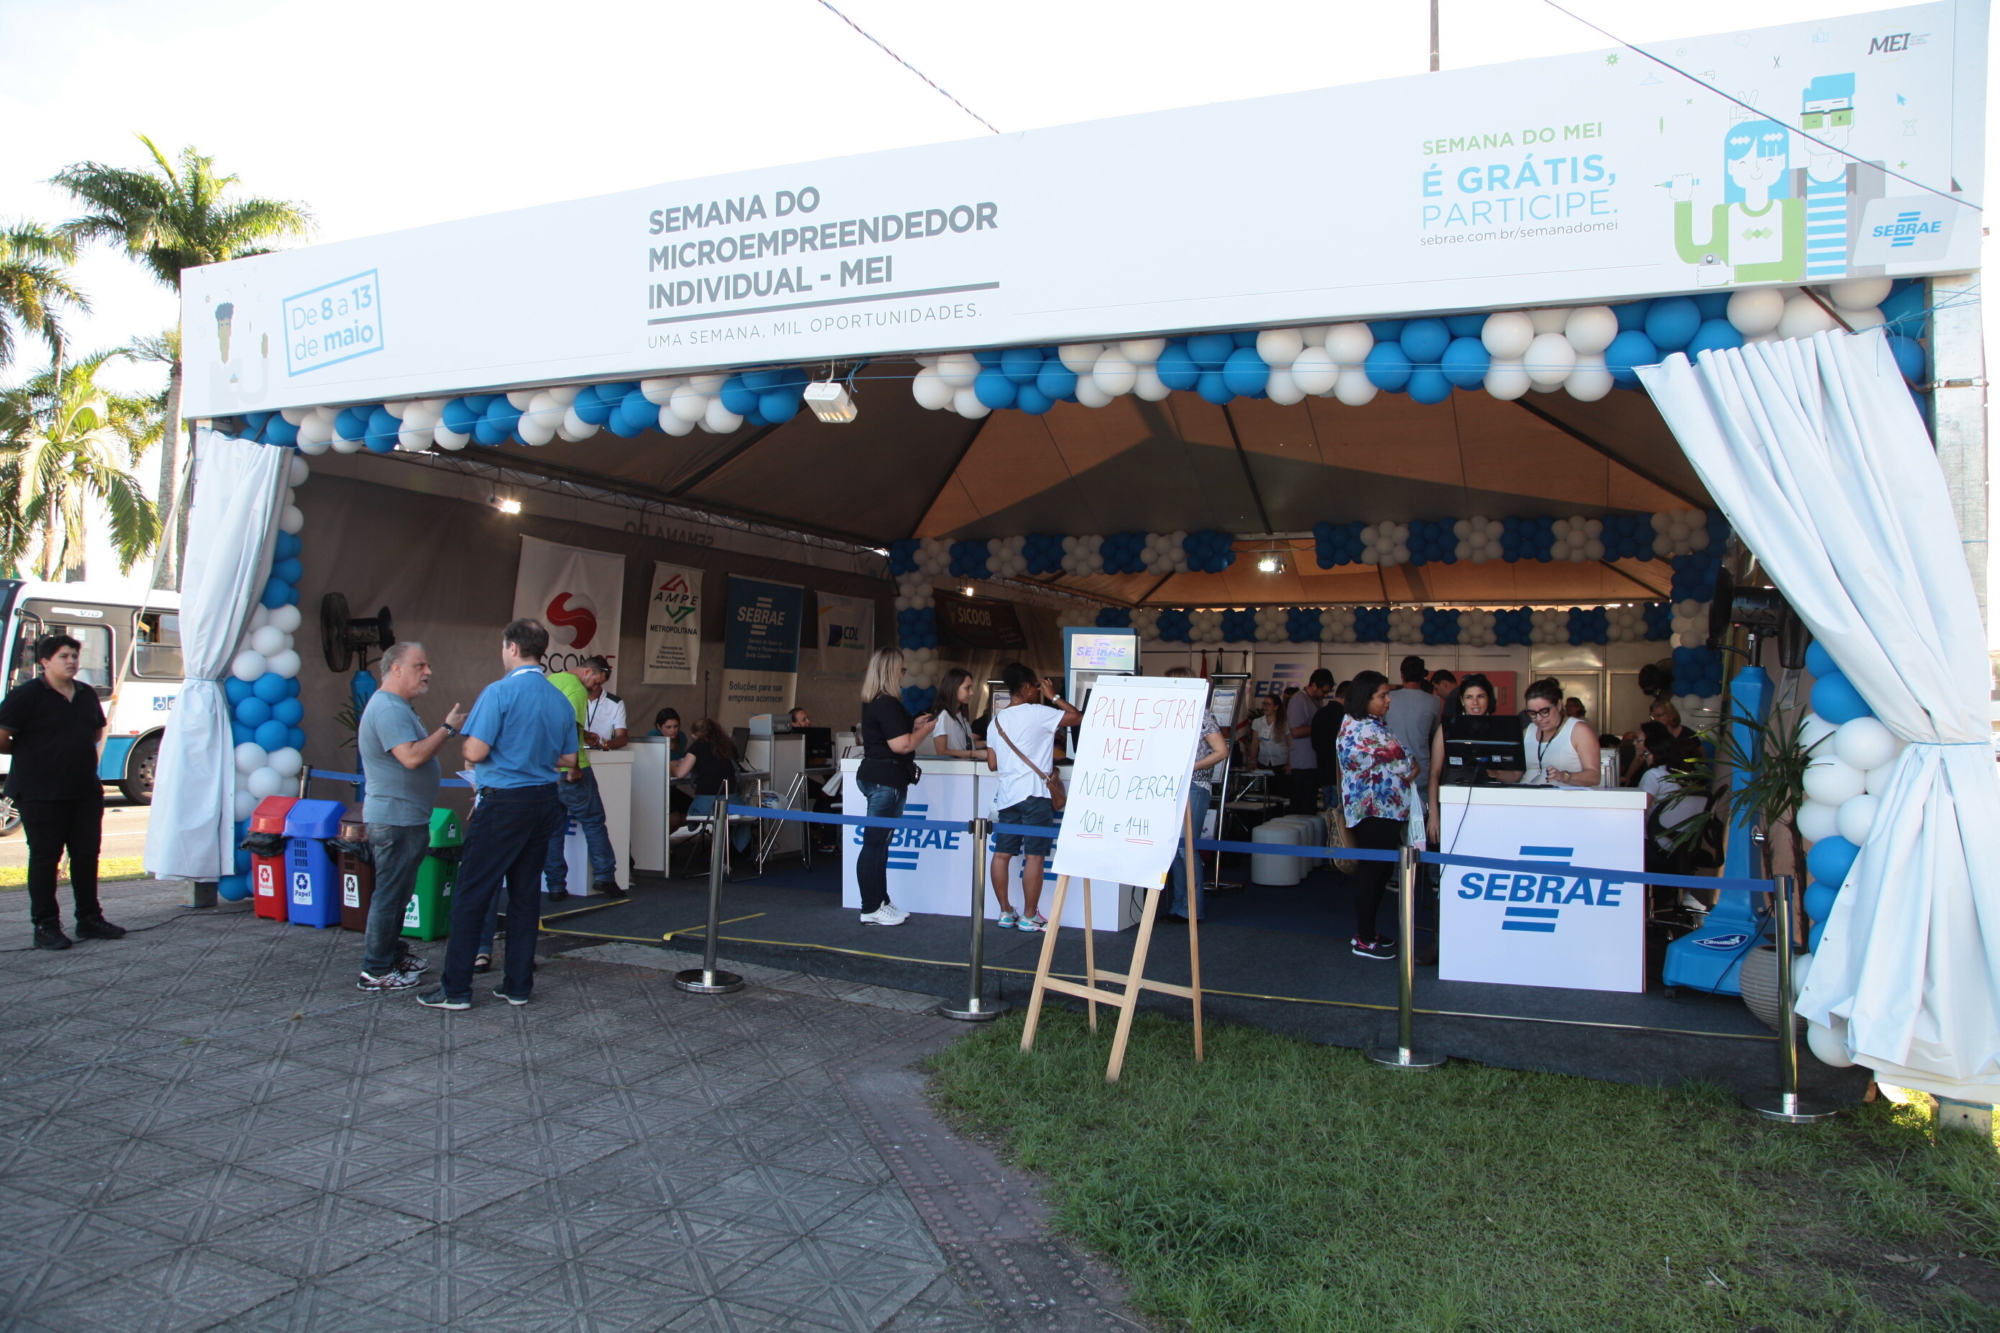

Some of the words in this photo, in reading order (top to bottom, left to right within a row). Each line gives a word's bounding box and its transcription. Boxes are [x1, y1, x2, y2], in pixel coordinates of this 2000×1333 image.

[1868, 32, 1911, 55] MEI
[1422, 130, 1514, 156] SEMANA
[1525, 126, 1556, 145] DO
[1563, 120, 1602, 140] MEI
[1422, 163, 1443, 197] É
[1457, 154, 1617, 193] GRÁTIS,
[648, 194, 767, 235] SEMANA
[775, 186, 820, 217] DO
[1422, 189, 1619, 230] PARTICIPE.
[648, 201, 998, 272] MICROEMPREENDEDOR
[1420, 219, 1619, 246] sebrae.com.br/semanadomei
[1872, 220, 1942, 238] SEBRAE
[648, 266, 812, 309] INDIVIDUAL
[840, 255, 893, 287] MEI
[292, 307, 317, 330] De
[321, 297, 333, 320] 8
[337, 298, 348, 316] a
[351, 284, 372, 310] 13
[648, 333, 682, 349] UMA
[689, 325, 766, 345] SEMANA,
[773, 319, 802, 336] MIL
[810, 302, 983, 333] OPORTUNIDADES.
[294, 335, 318, 360] de
[323, 319, 374, 352] maio
[654, 592, 698, 605] AMPE
[737, 606, 785, 626] SEBRAE
[957, 606, 992, 627] SICOOB
[650, 625, 697, 635] METROPOLITANA
[843, 626, 858, 641] CDL
[1076, 646, 1126, 658] SEBRAE
[728, 694, 754, 703] empresa
[756, 695, 784, 703] acontecer
[729, 681, 757, 692] Soluções
[758, 684, 771, 692] para
[1093, 696, 1197, 731] PALESTRA
[1103, 738, 1143, 762] MEI
[1079, 768, 1120, 801] NÃO
[1127, 774, 1182, 803] PERCA!
[1079, 809, 1104, 834] 10H
[1126, 815, 1150, 837] 14H
[295, 890, 311, 898] Papel
[1457, 872, 1626, 907] SEBRAE
